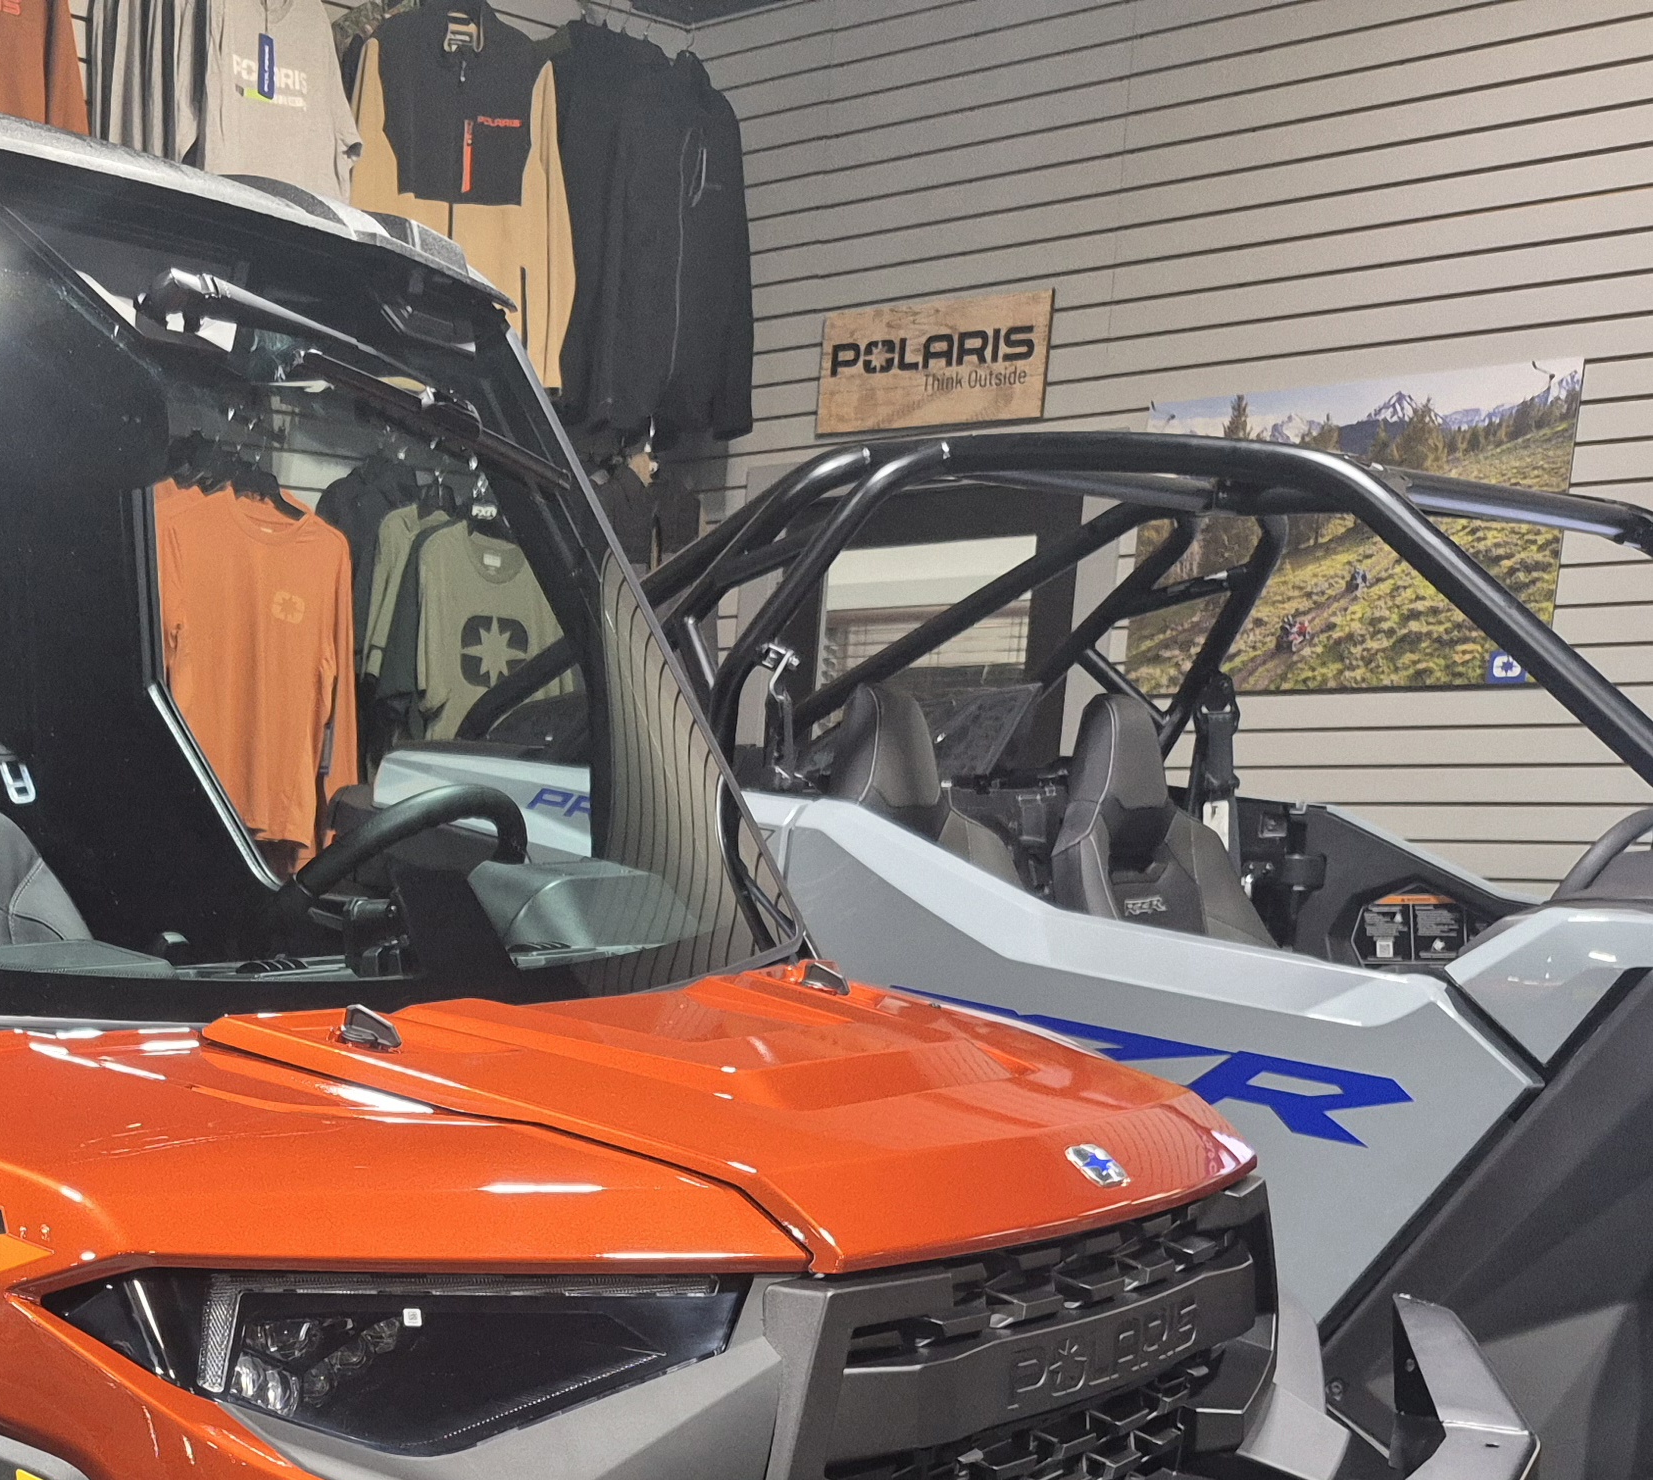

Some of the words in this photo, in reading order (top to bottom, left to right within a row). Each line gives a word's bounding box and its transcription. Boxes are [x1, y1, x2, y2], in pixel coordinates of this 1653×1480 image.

[830, 325, 1036, 378] POLARIS
[923, 371, 964, 393] Think
[967, 365, 1027, 389] Outside
[1005, 1300, 1197, 1411] POLARIS
